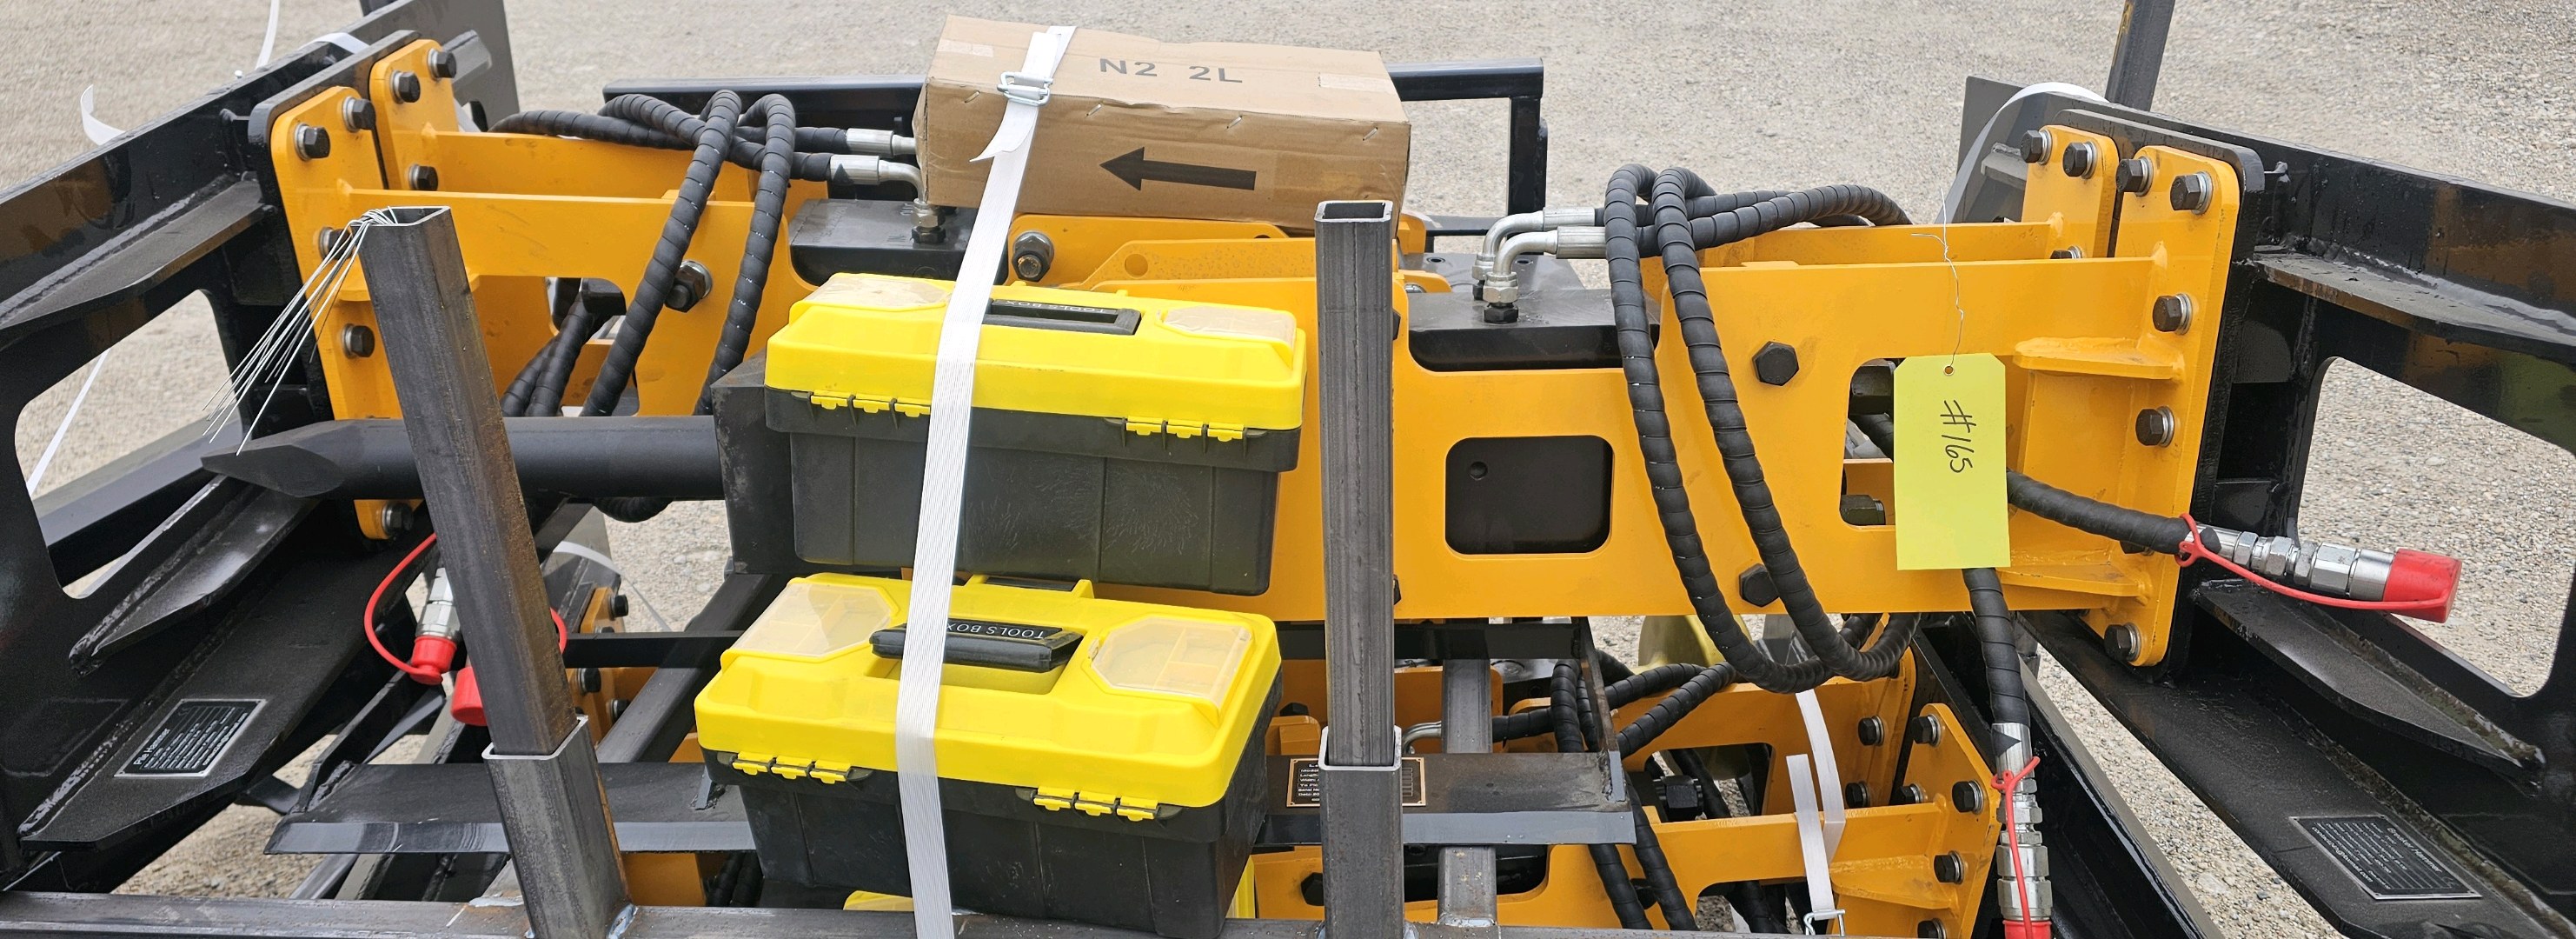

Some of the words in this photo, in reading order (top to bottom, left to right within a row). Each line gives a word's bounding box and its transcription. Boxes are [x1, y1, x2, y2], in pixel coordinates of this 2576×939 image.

[1099, 57, 1158, 77] N2
[1188, 65, 1243, 83] 2L
[1005, 299, 1042, 309] BOX
[1048, 304, 1105, 314] TOOLS
[1939, 399, 1977, 473] #165
[946, 623, 982, 634] BOX
[986, 625, 1045, 640] TOOLS
[133, 753, 149, 765] Pile
[143, 728, 171, 753] Hammer
[2387, 828, 2415, 849] Breaker
[2410, 848, 2443, 874] Hammer
